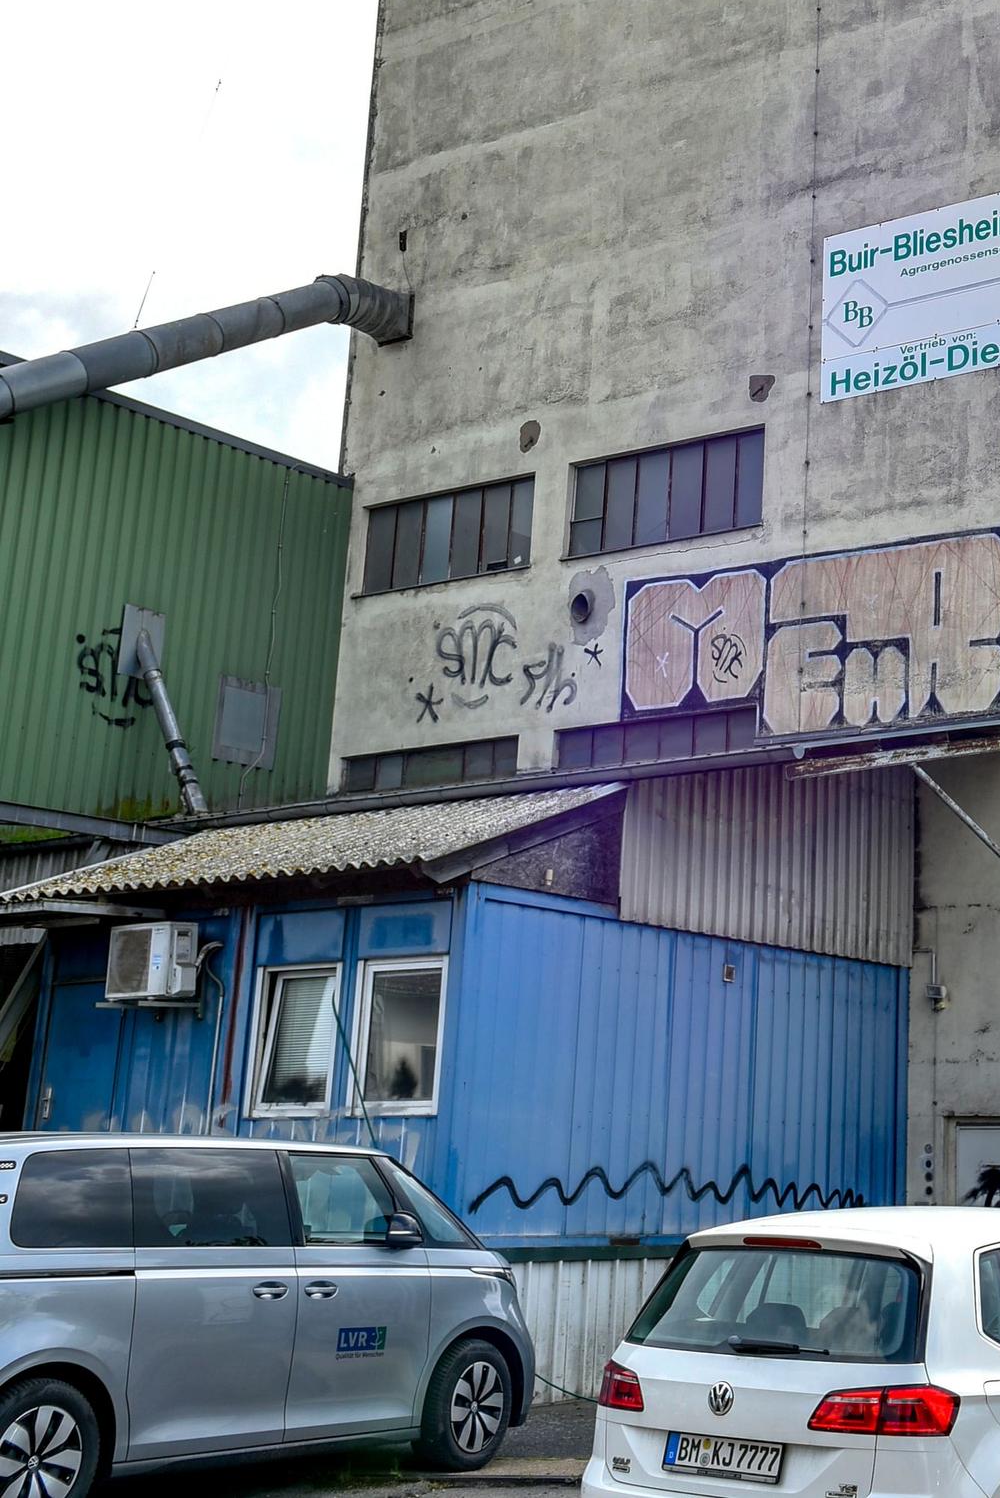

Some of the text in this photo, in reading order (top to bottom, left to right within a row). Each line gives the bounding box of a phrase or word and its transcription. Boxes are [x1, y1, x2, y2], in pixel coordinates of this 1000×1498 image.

[843, 300, 874, 329] BB
[900, 331, 977, 355] Vertrieb von:
[340, 1331, 368, 1348] LVR
[677, 1436, 781, 1472] BM KJ 7777
